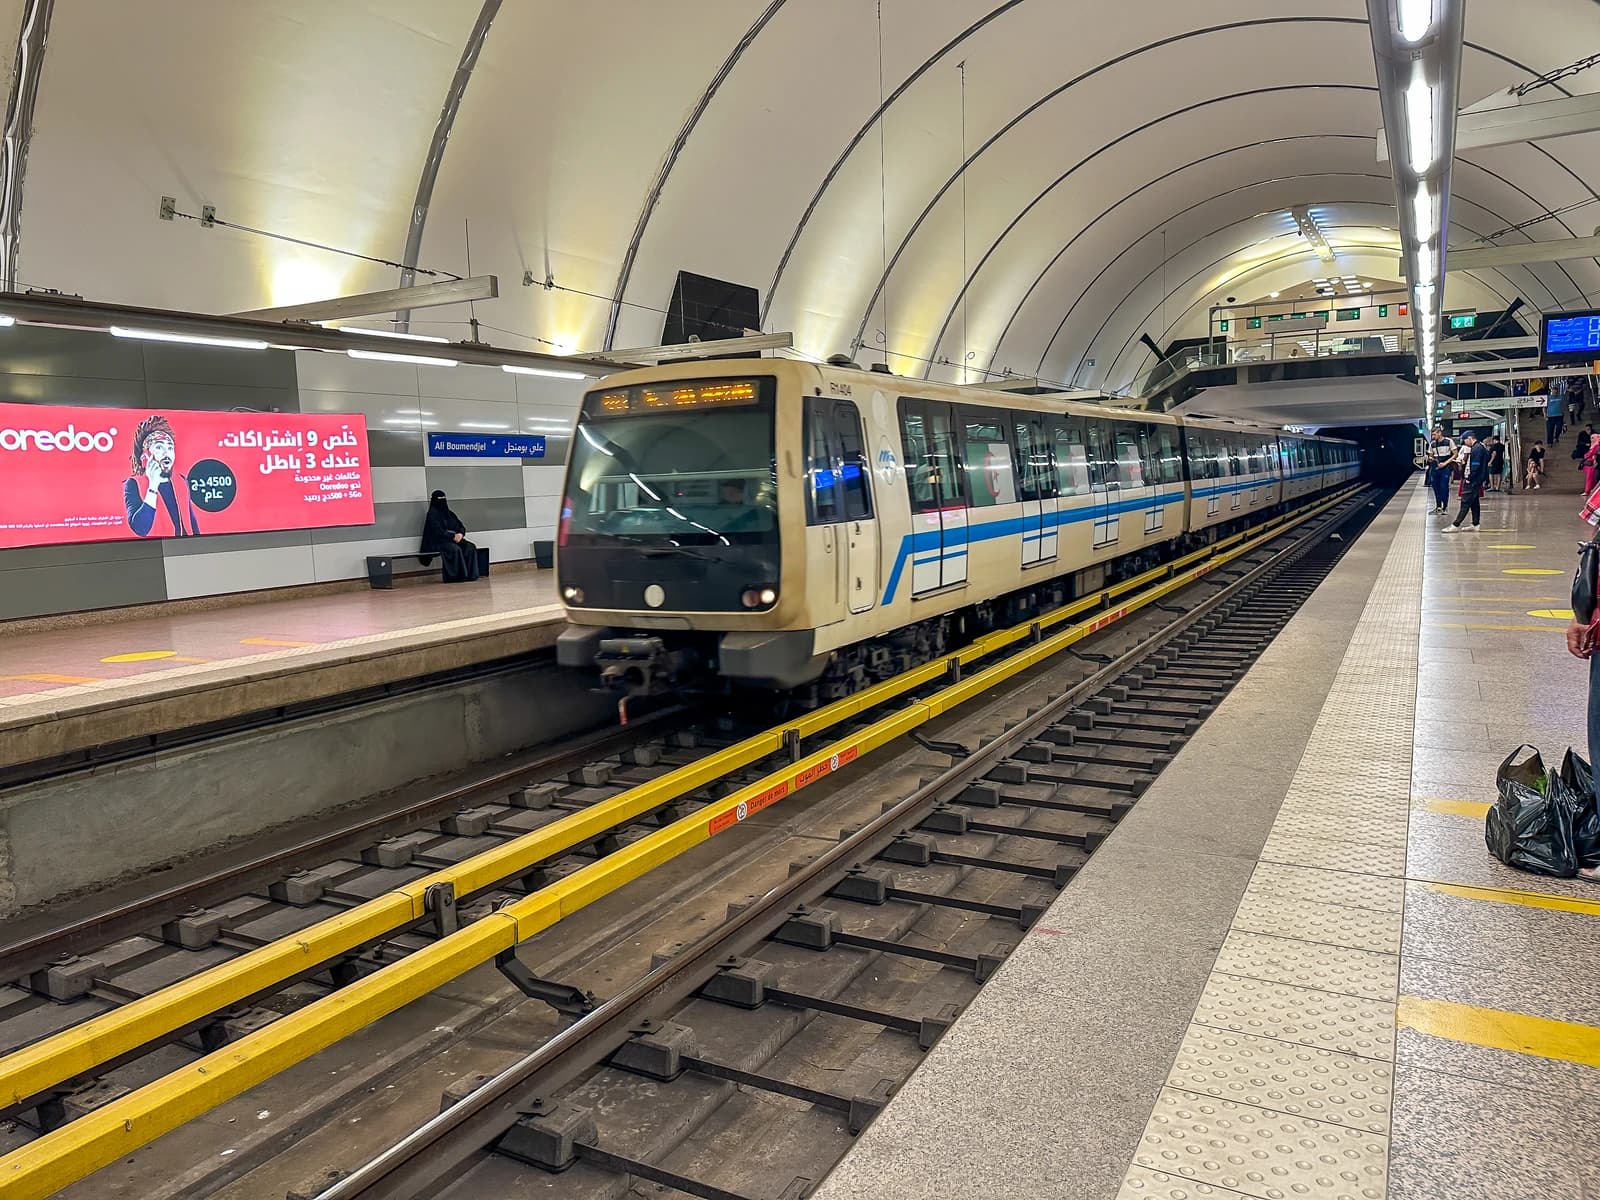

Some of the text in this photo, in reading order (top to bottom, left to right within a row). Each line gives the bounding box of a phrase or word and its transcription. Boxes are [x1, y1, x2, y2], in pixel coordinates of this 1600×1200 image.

[307, 431, 318, 447] 9
[434, 441, 486, 452] Ali Boumendjel
[504, 442, 544, 455] علي بومنجل
[260, 452, 360, 475] عندك 3 باطل
[294, 472, 361, 483] مكالمات غير محدودة
[319, 480, 361, 490] نحو Ooredoo
[303, 494, 321, 503] رصيد
